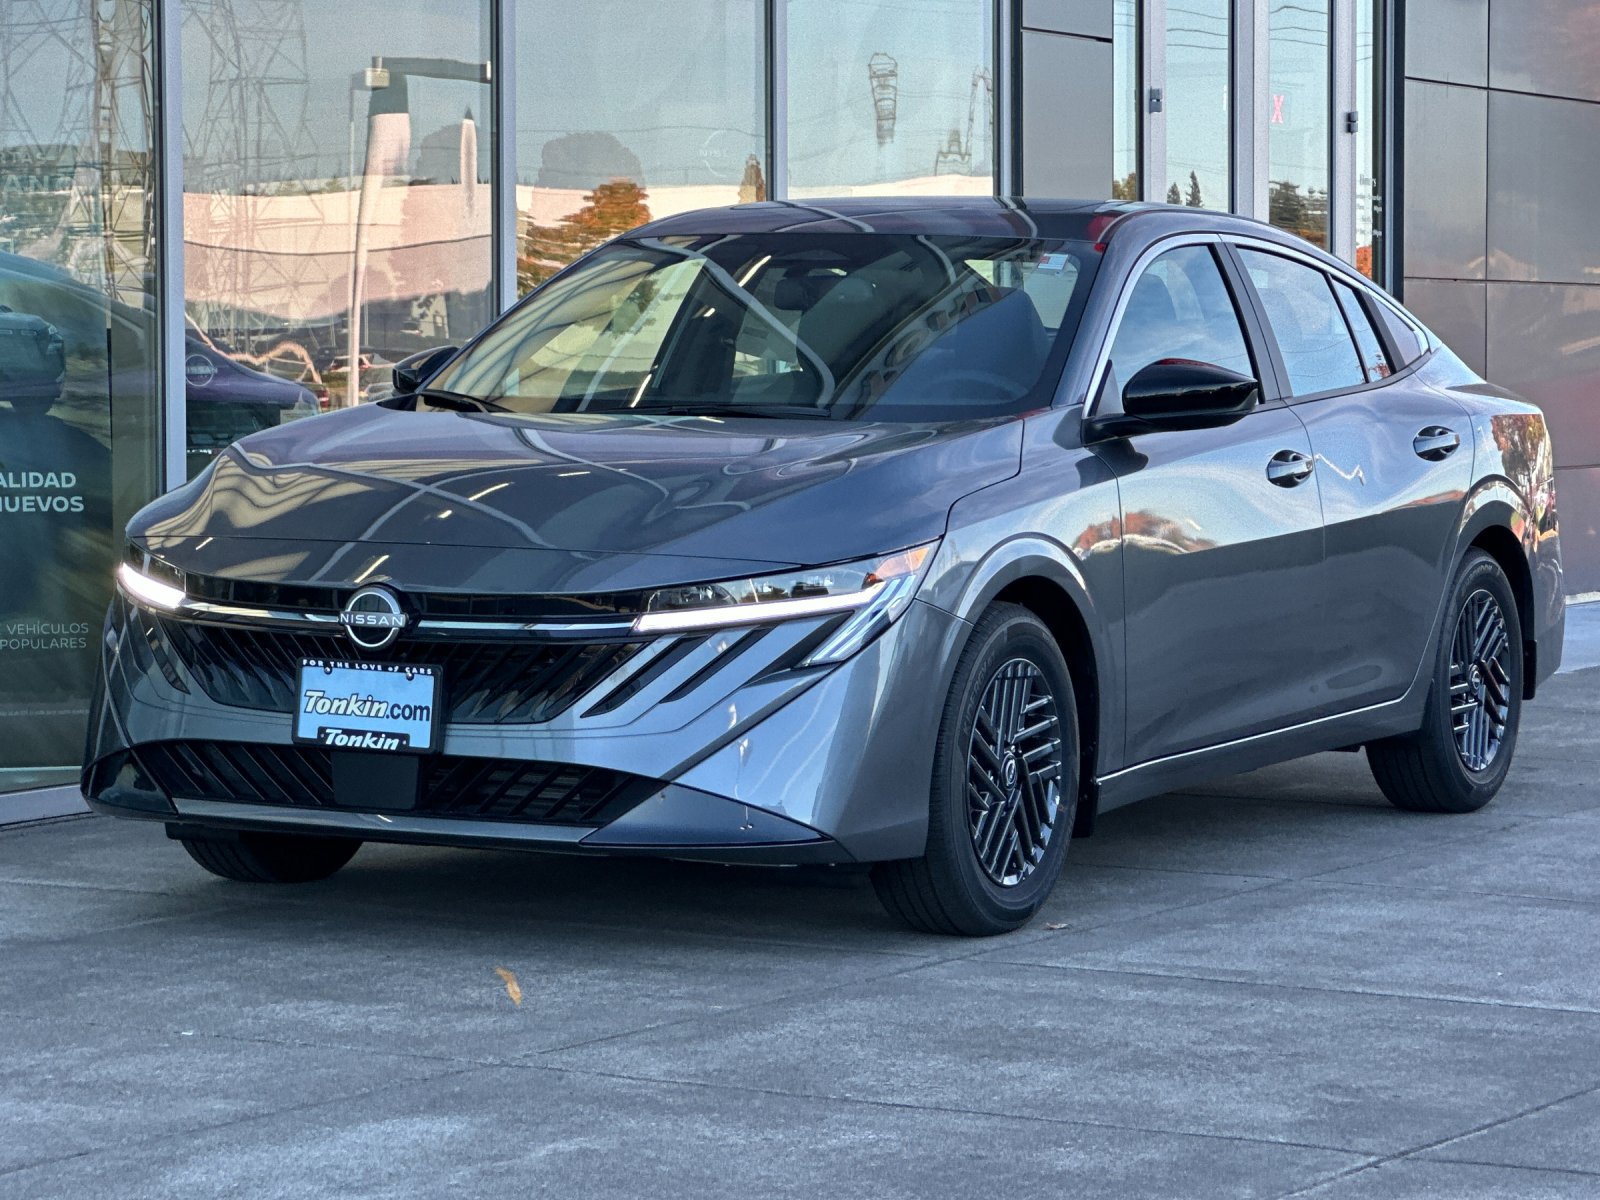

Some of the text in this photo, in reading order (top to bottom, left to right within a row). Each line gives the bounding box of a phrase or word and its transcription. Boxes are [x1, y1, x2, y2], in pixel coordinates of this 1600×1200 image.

[186, 366, 218, 374] ISSAN
[0, 496, 84, 512] UEVOS
[340, 613, 403, 626] NISSAN
[7, 620, 89, 635] VEHÍCULOS
[0, 637, 87, 650] POPULARES
[302, 659, 324, 667] FOR
[329, 661, 349, 669] THE
[355, 663, 382, 671] LOVE
[405, 667, 432, 675] CARS
[304, 690, 430, 721] Tonkin.com
[325, 729, 399, 750] Tonkin
